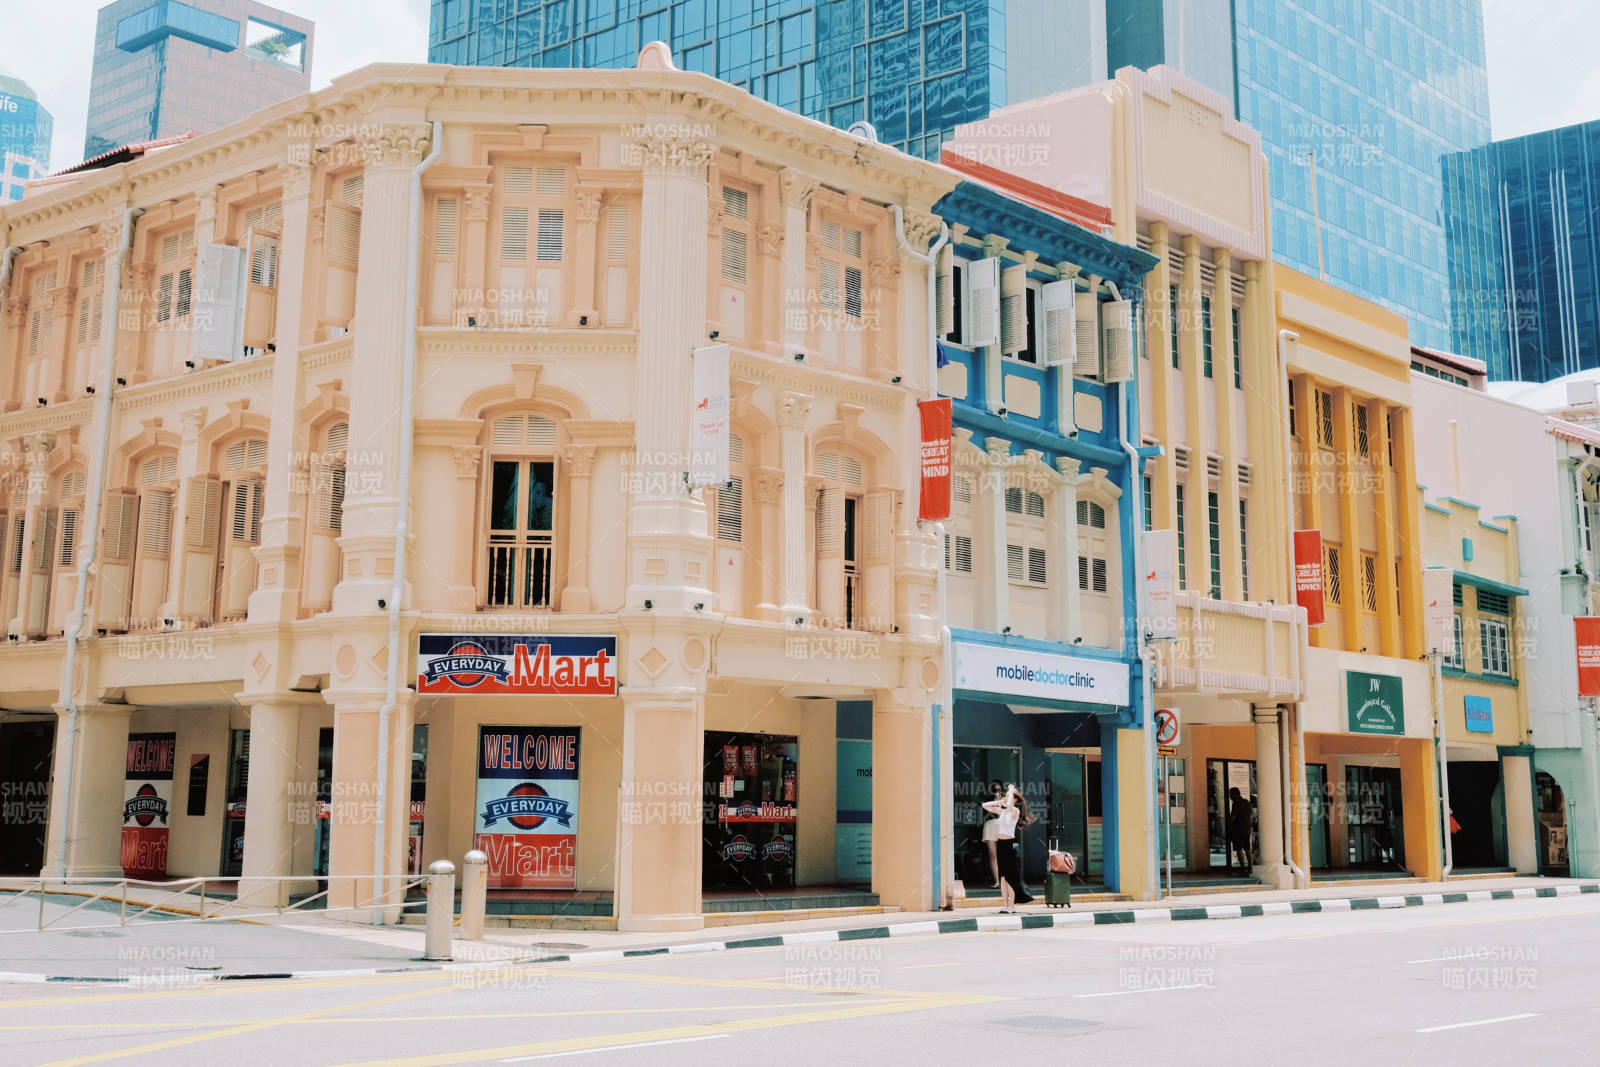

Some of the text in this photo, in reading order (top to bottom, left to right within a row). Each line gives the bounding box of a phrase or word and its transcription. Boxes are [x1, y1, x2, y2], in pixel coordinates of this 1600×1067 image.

[921, 446, 949, 457] GREAT
[922, 465, 949, 477] MIND
[434, 643, 611, 687] EVERYDAY Mart
[996, 664, 1095, 688] mobiledoctorclinic
[1370, 678, 1380, 692] JW
[127, 740, 175, 772] WELCOME
[484, 735, 576, 770] WELCOME
[128, 800, 165, 814] EVERYDAY
[492, 800, 564, 815] EVERYDAY
[761, 801, 793, 819] Mart
[121, 830, 168, 871] Mart
[478, 834, 575, 877] Mart
[727, 843, 752, 853] EVERYDAY
[766, 843, 791, 853] EVERYDAY
